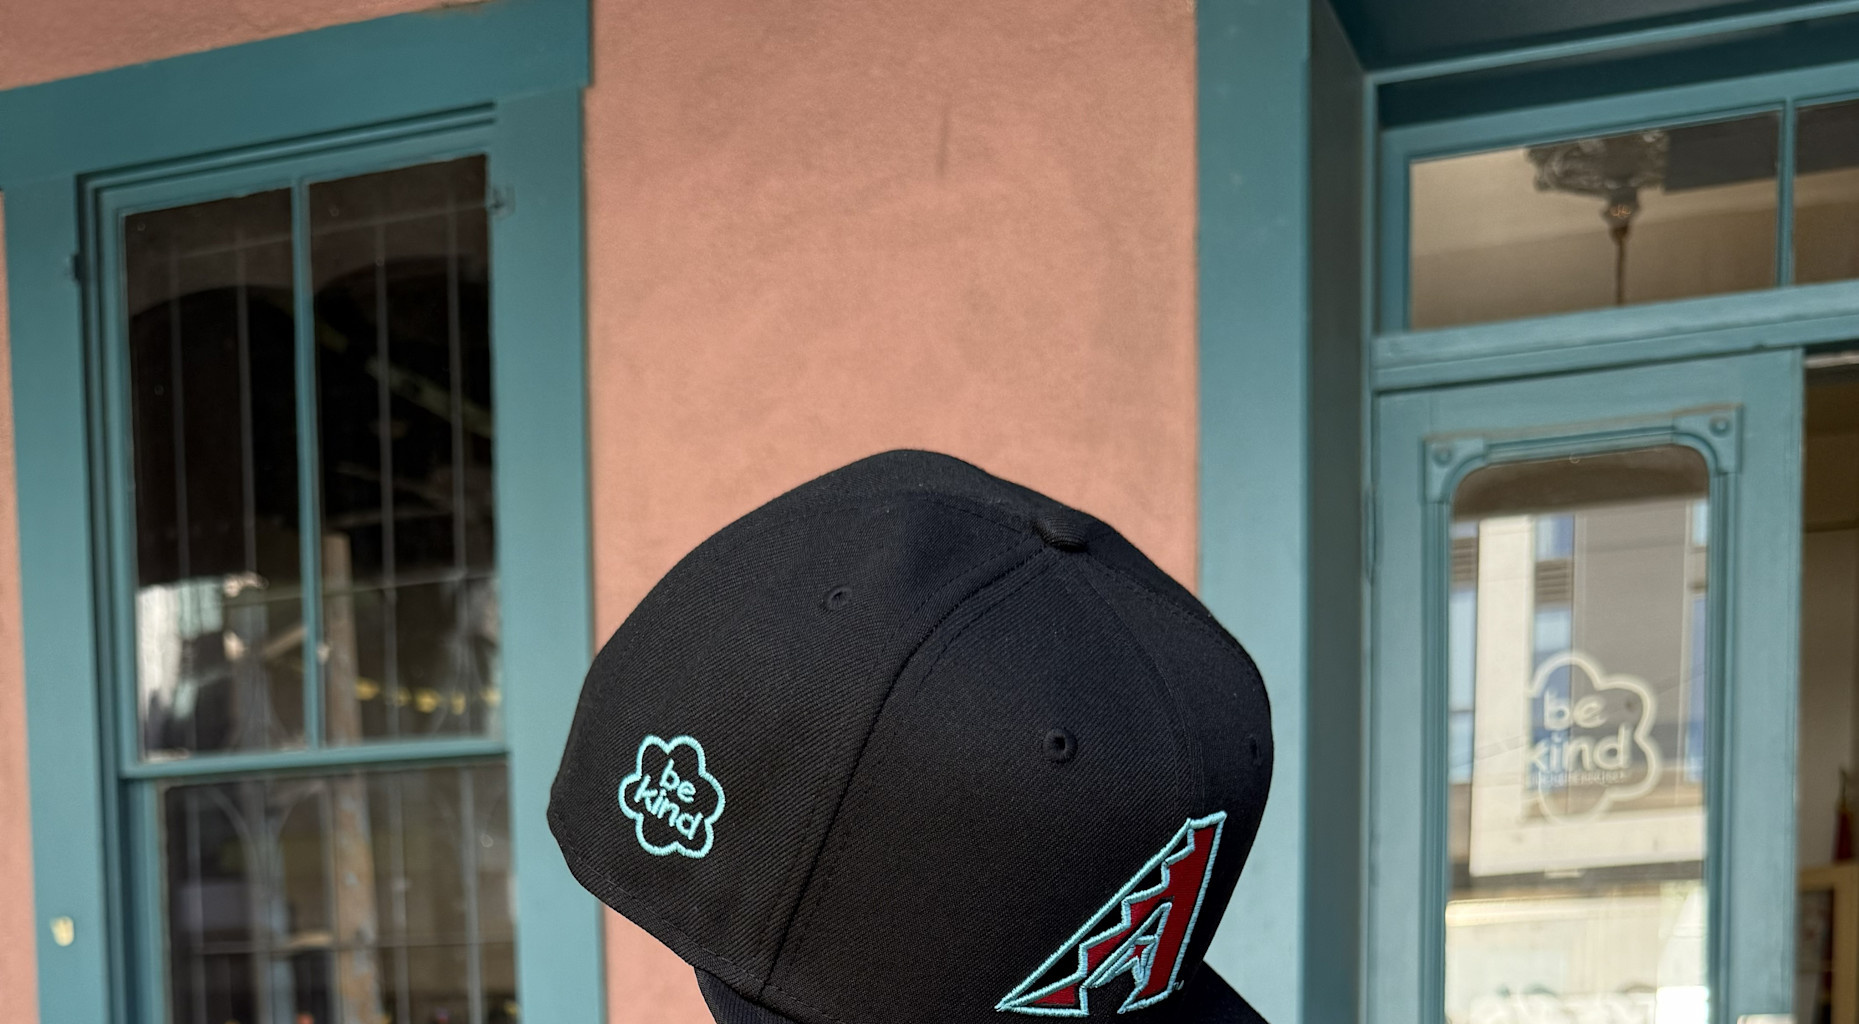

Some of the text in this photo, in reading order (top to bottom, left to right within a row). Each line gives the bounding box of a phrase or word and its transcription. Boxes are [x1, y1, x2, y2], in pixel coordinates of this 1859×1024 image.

[1544, 688, 1607, 731] be
[659, 758, 696, 803] be
[634, 774, 704, 840] kind
